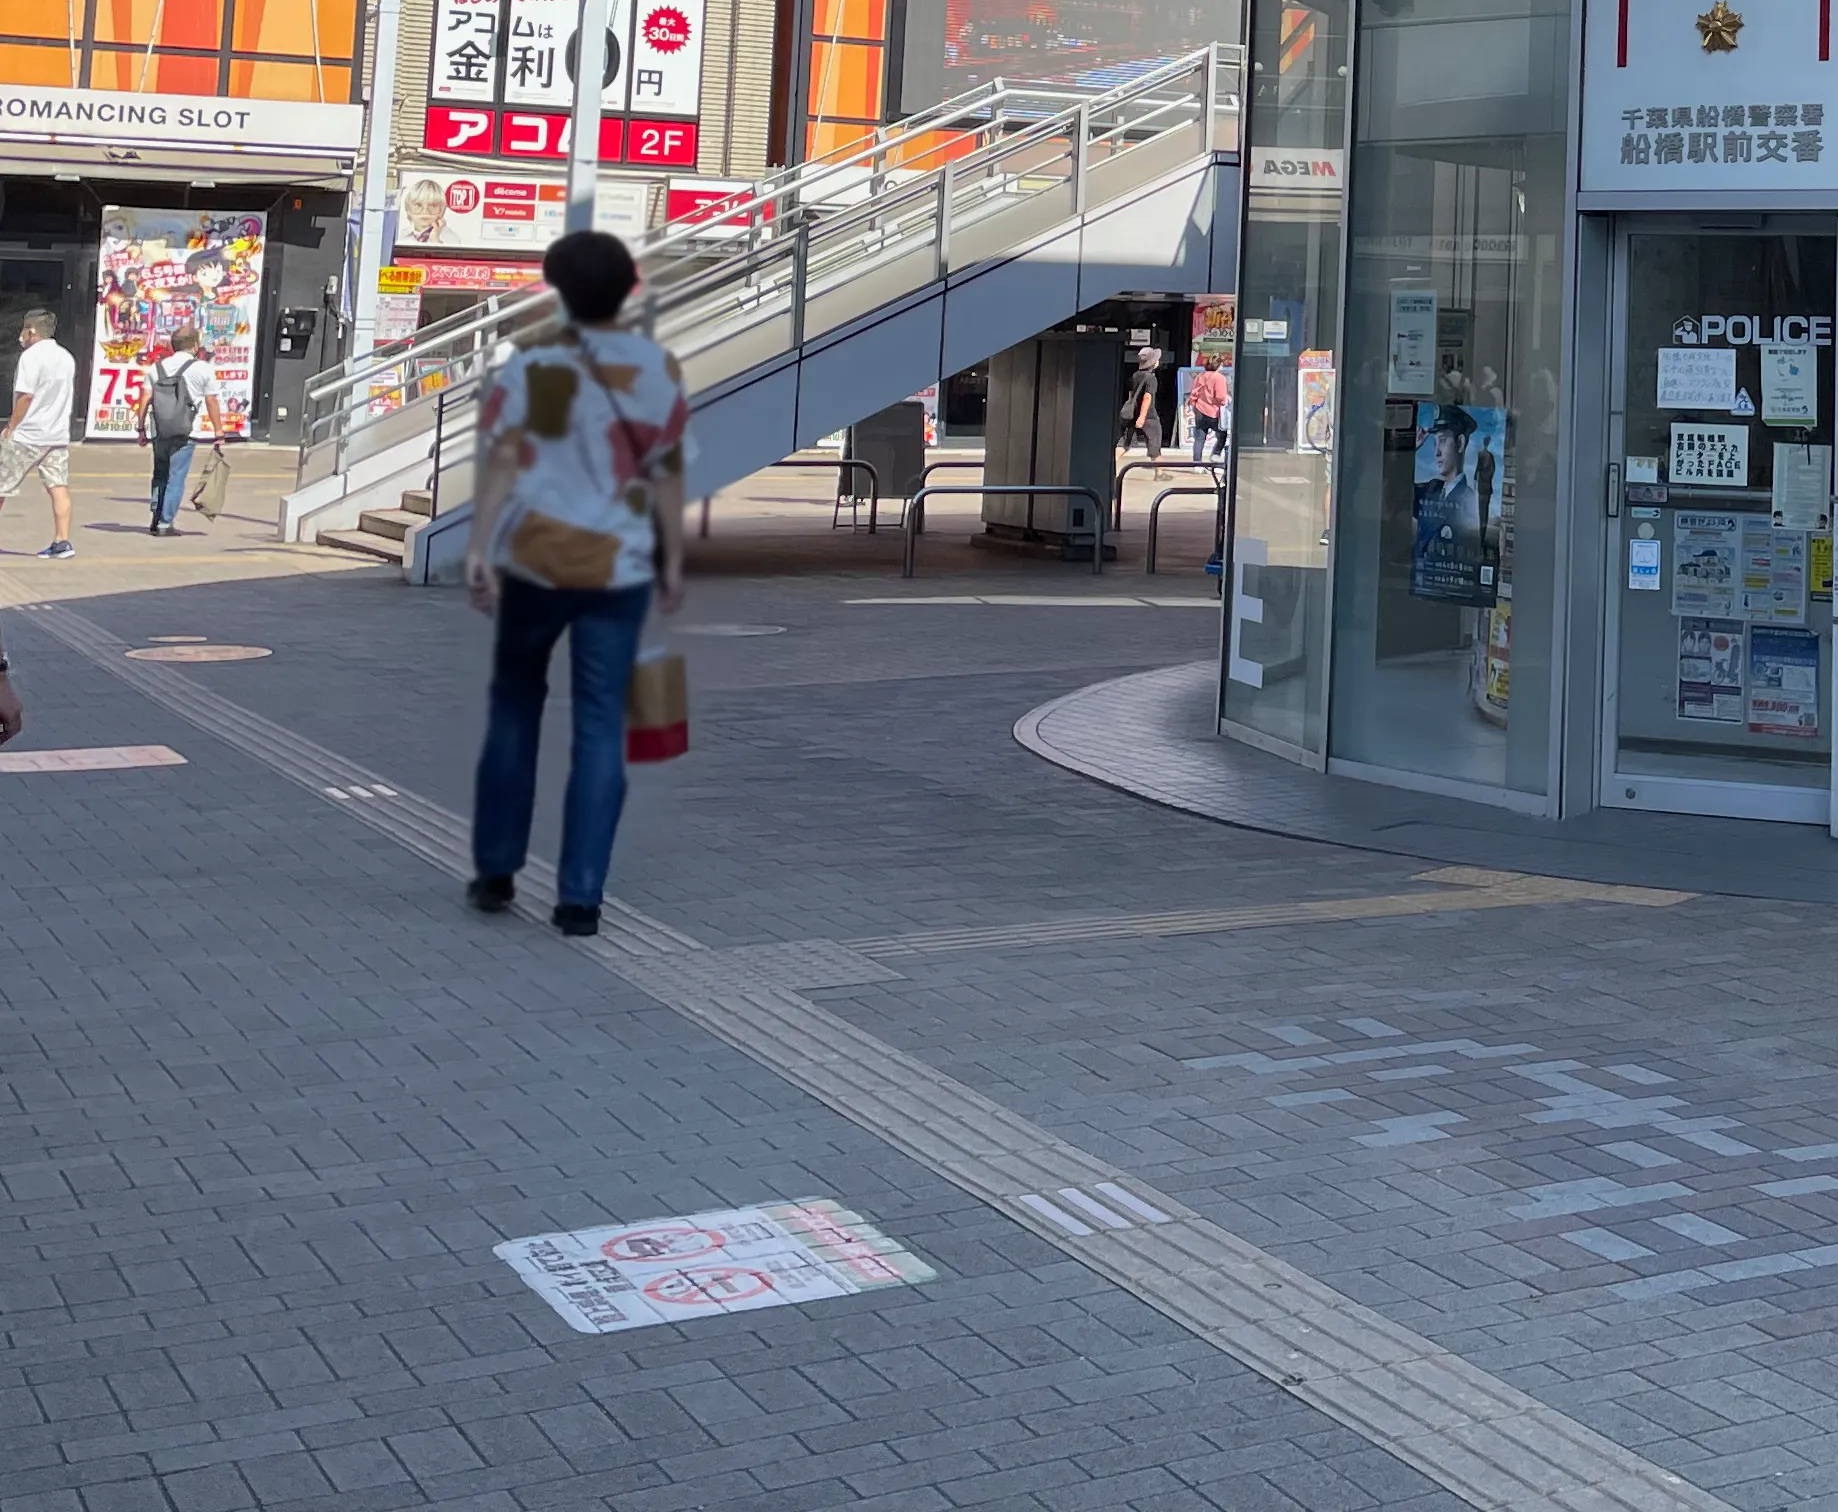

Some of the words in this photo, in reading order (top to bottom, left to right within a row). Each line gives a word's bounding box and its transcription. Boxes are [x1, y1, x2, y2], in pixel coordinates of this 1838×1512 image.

[447, 10, 554, 39] アコムは
[0, 98, 167, 125] OMANCING
[178, 108, 250, 129] SLOT
[1620, 103, 1825, 131] 千葉県船橋警察署
[640, 129, 684, 156] 2F
[1619, 129, 1825, 165] 船橋駅前交番
[1701, 315, 1832, 346] POLICE
